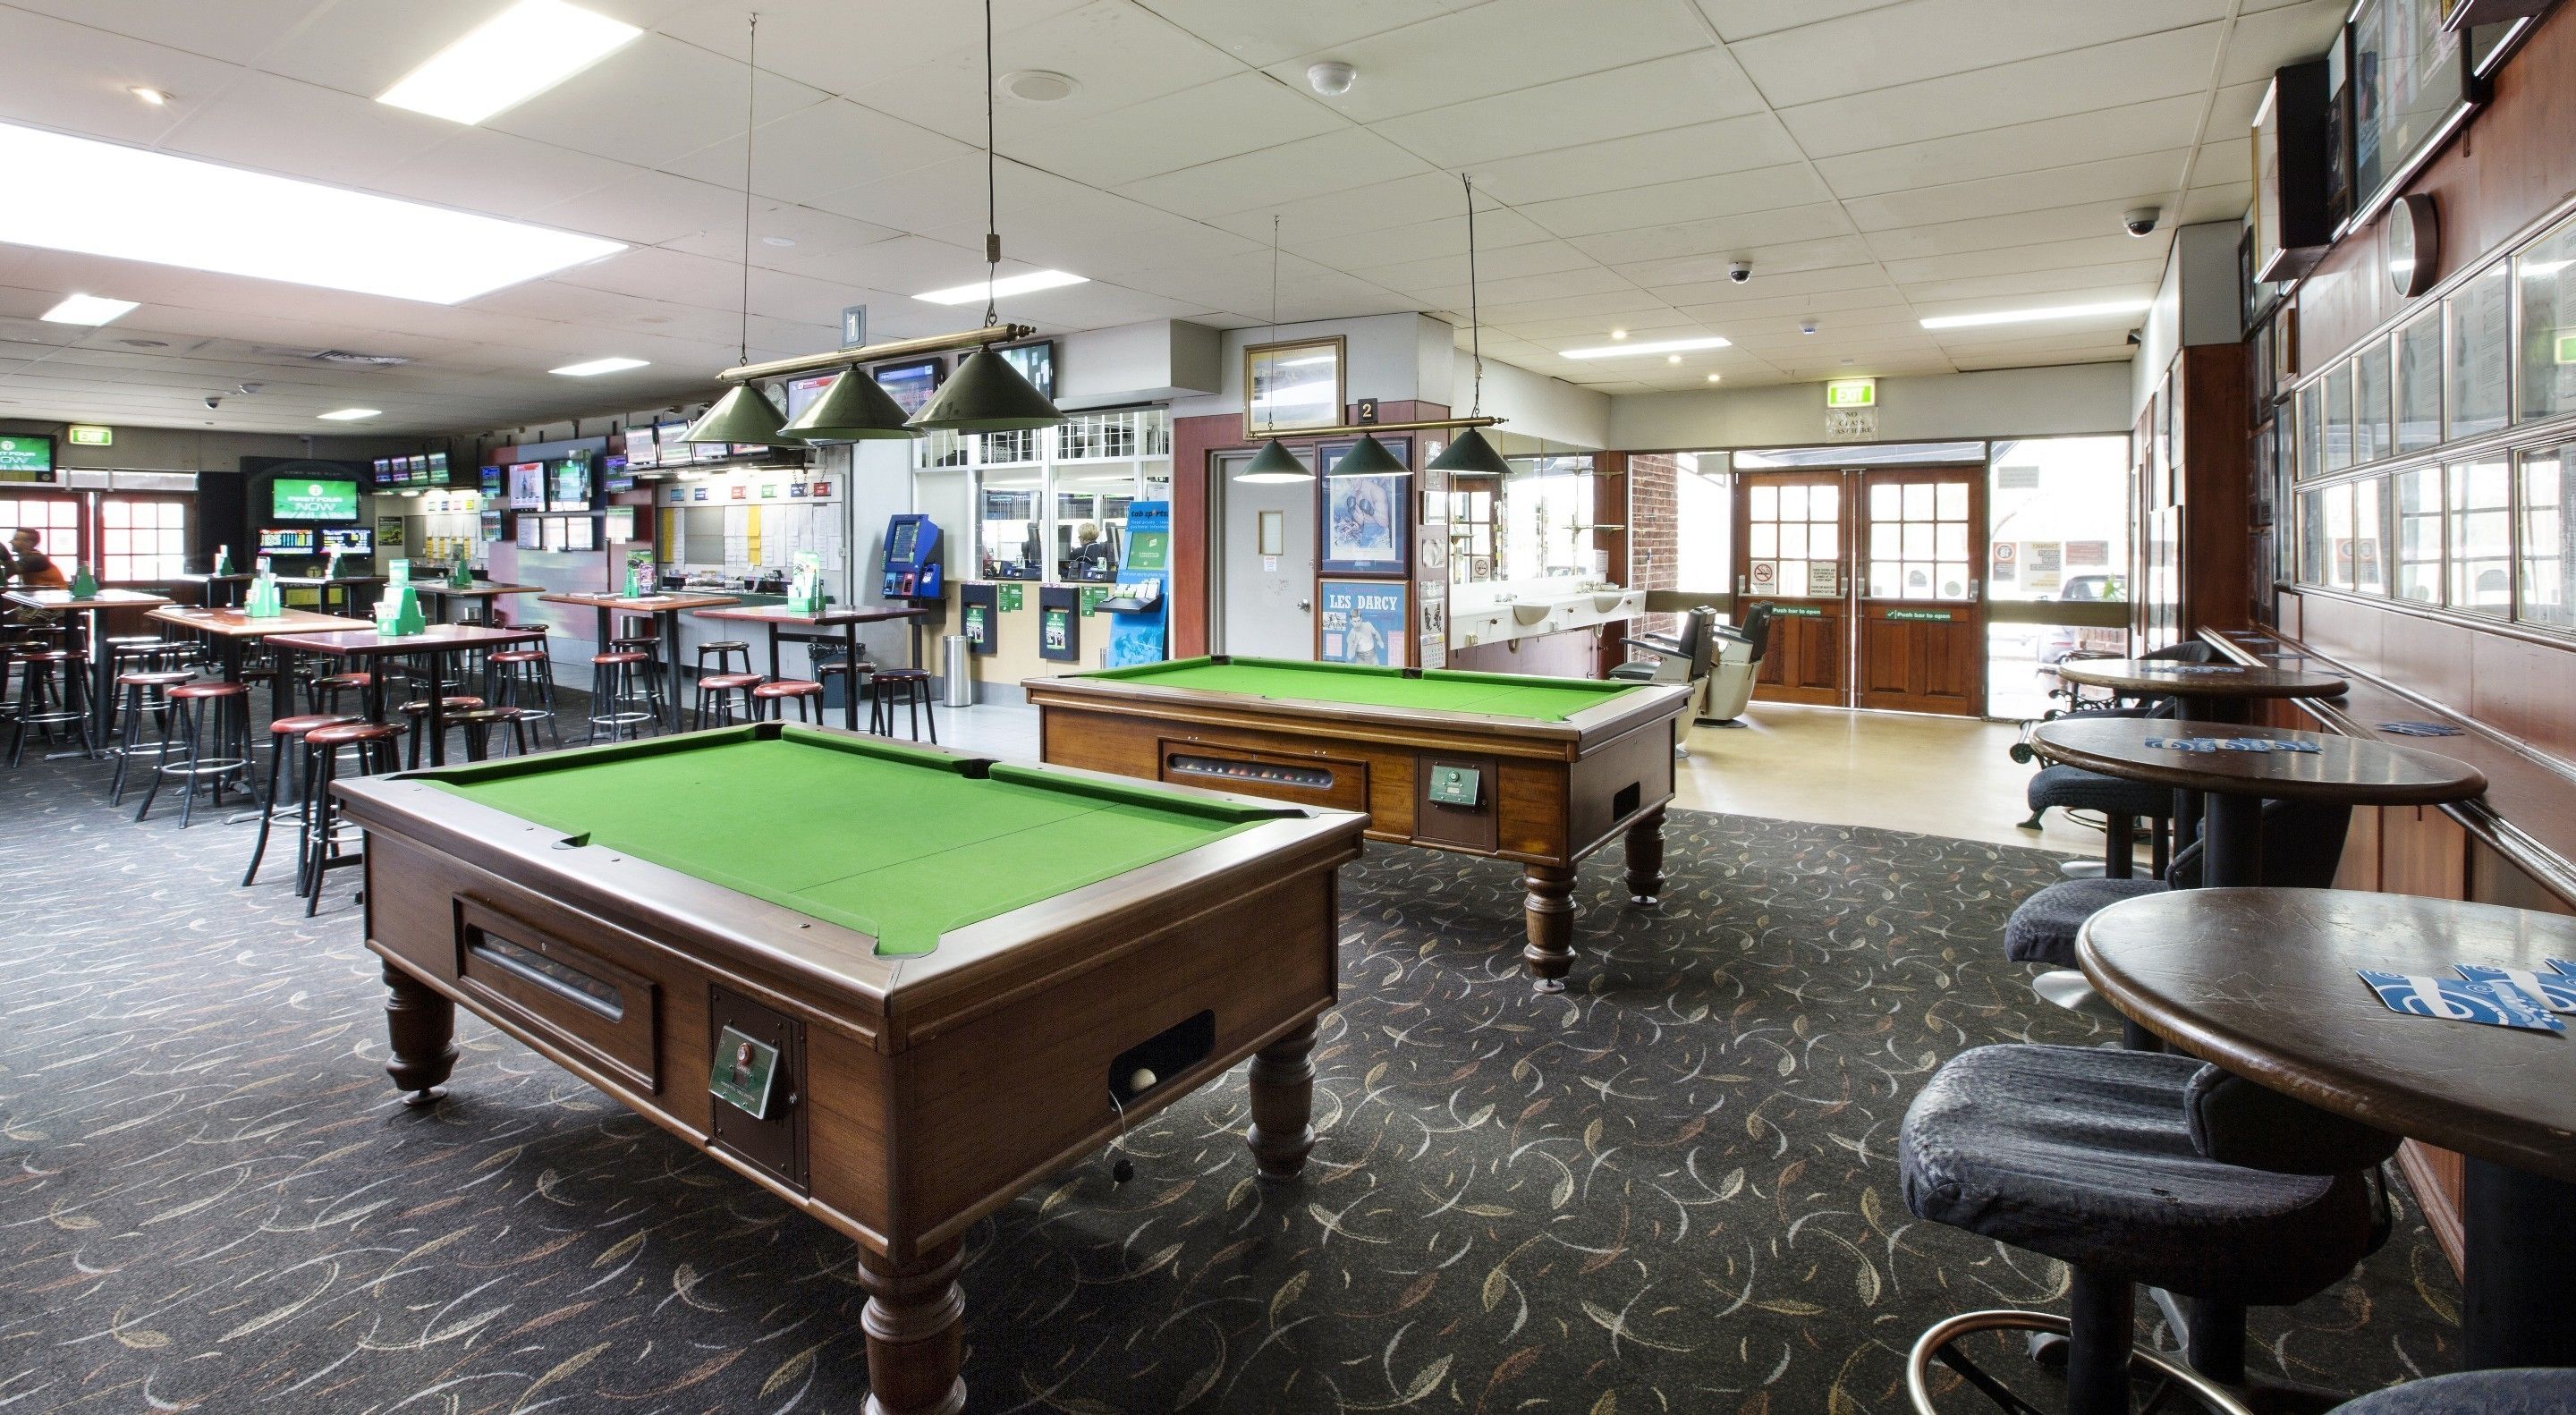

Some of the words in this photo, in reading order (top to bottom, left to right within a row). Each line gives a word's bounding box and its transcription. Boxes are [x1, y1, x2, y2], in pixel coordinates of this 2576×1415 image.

[1362, 403, 1372, 418] 2
[294, 503, 337, 511] NOW
[1330, 595, 1351, 609] LES
[1358, 595, 1398, 611] DARCY
